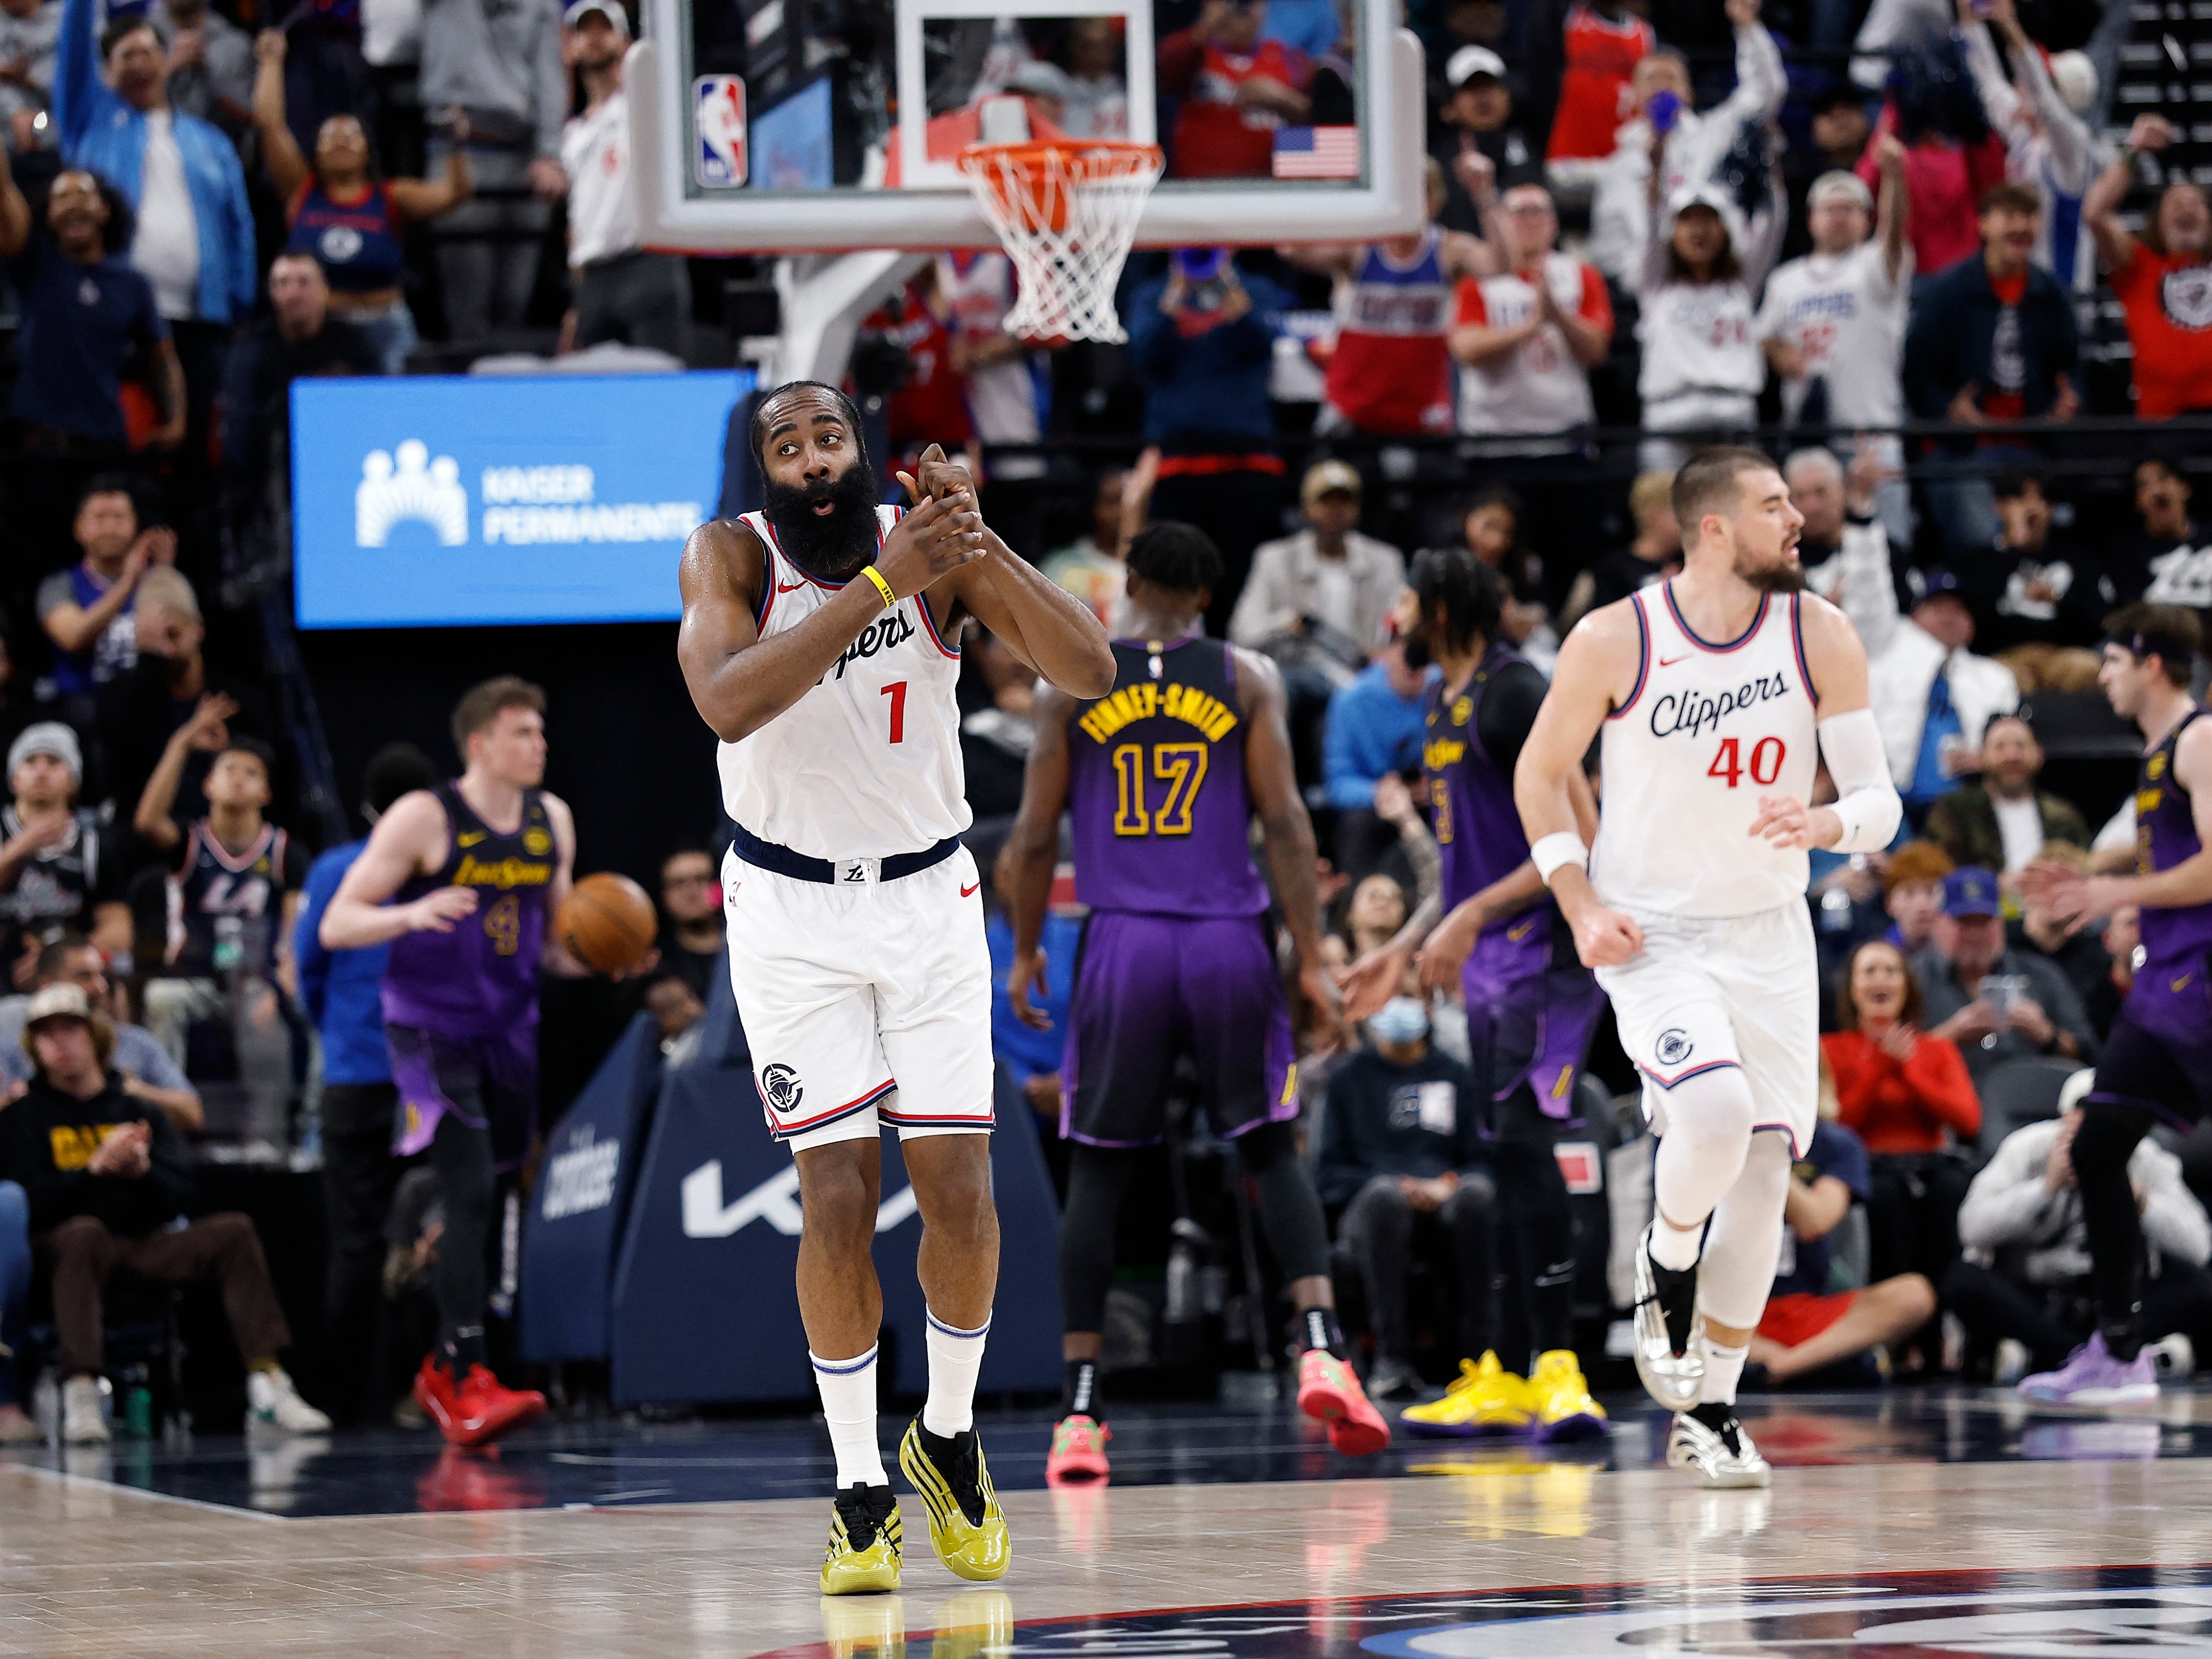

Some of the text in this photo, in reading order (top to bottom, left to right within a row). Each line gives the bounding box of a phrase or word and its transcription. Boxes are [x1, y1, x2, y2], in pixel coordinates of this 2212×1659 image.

[880, 681, 907, 744] 1
[1079, 682, 1238, 745] FINNEY-SMITH
[1651, 671, 1789, 738] Clippers
[1112, 742, 1208, 836] 17
[1708, 737, 1786, 787] 40
[483, 894, 521, 956] 4
